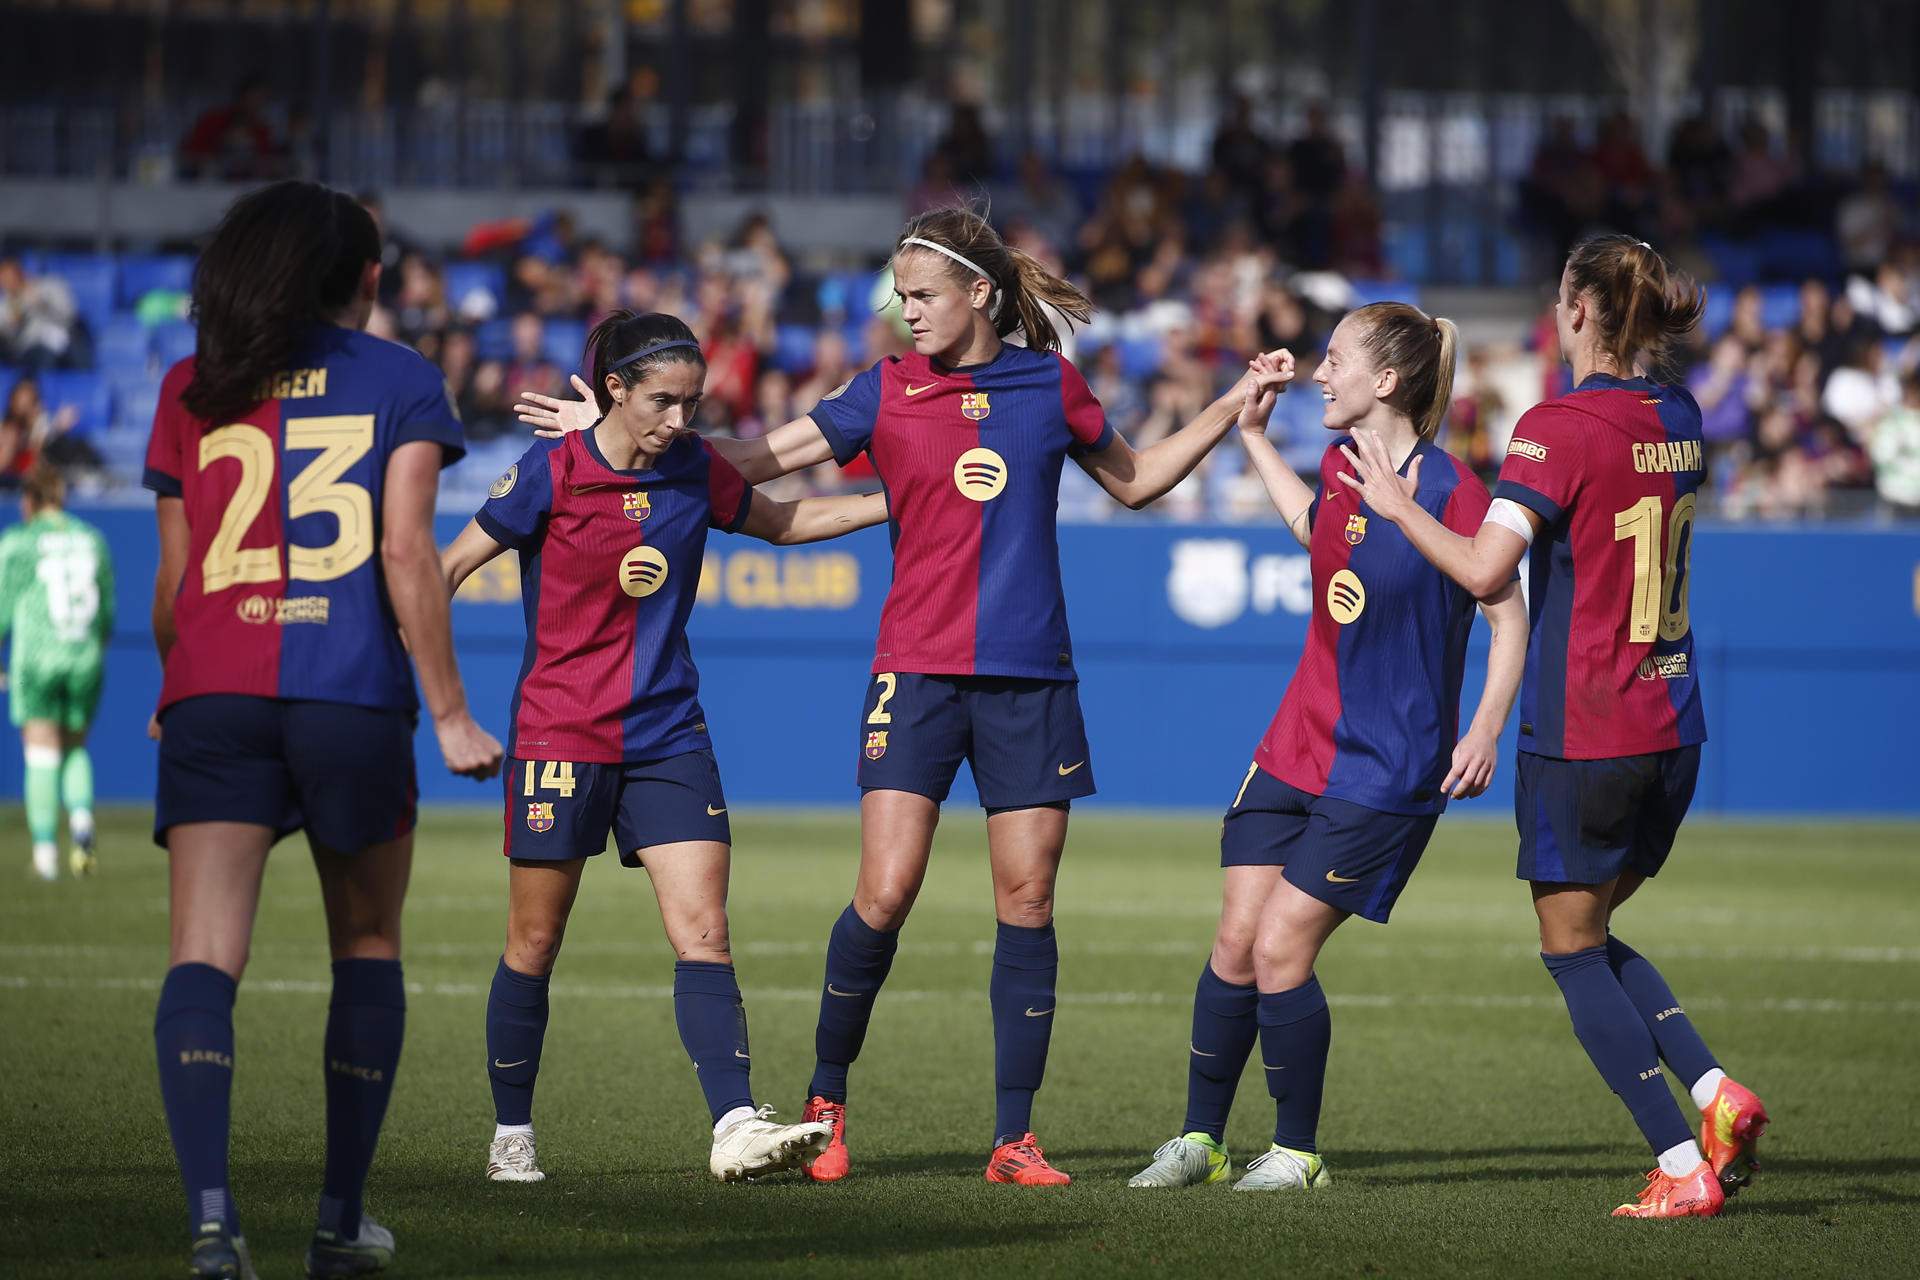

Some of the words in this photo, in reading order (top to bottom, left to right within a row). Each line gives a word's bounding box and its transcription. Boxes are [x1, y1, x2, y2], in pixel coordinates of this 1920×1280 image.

[1508, 441, 1547, 460] BIMBO
[198, 414, 376, 595] 23
[725, 550, 859, 609] CLUB
[1615, 493, 1697, 642] 10
[1653, 653, 1687, 666] UNHCR
[1658, 663, 1687, 676] ACNUR
[867, 672, 897, 724] 2
[523, 761, 576, 797] 14
